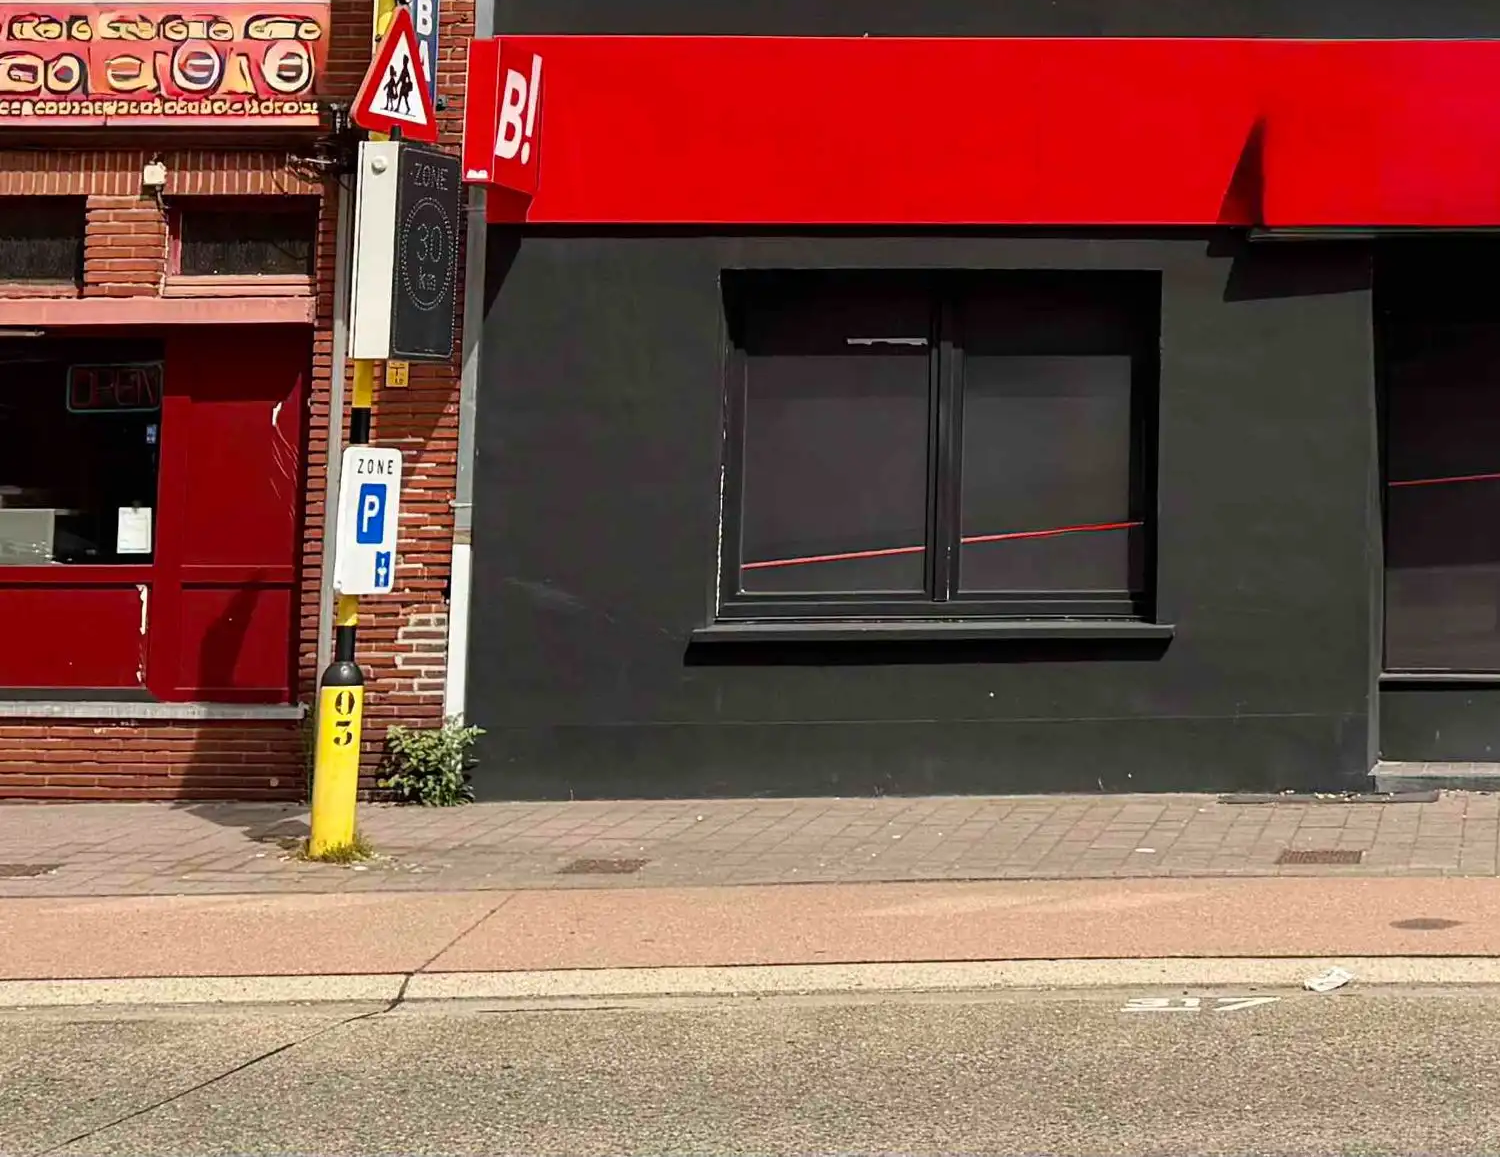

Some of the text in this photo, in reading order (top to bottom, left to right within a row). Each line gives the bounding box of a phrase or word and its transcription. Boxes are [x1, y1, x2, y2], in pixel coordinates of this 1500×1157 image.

[495, 53, 543, 165] B!
[413, 162, 449, 191] ZONE
[416, 222, 442, 263] 30
[357, 458, 394, 475] ZONE
[362, 494, 380, 533] P
